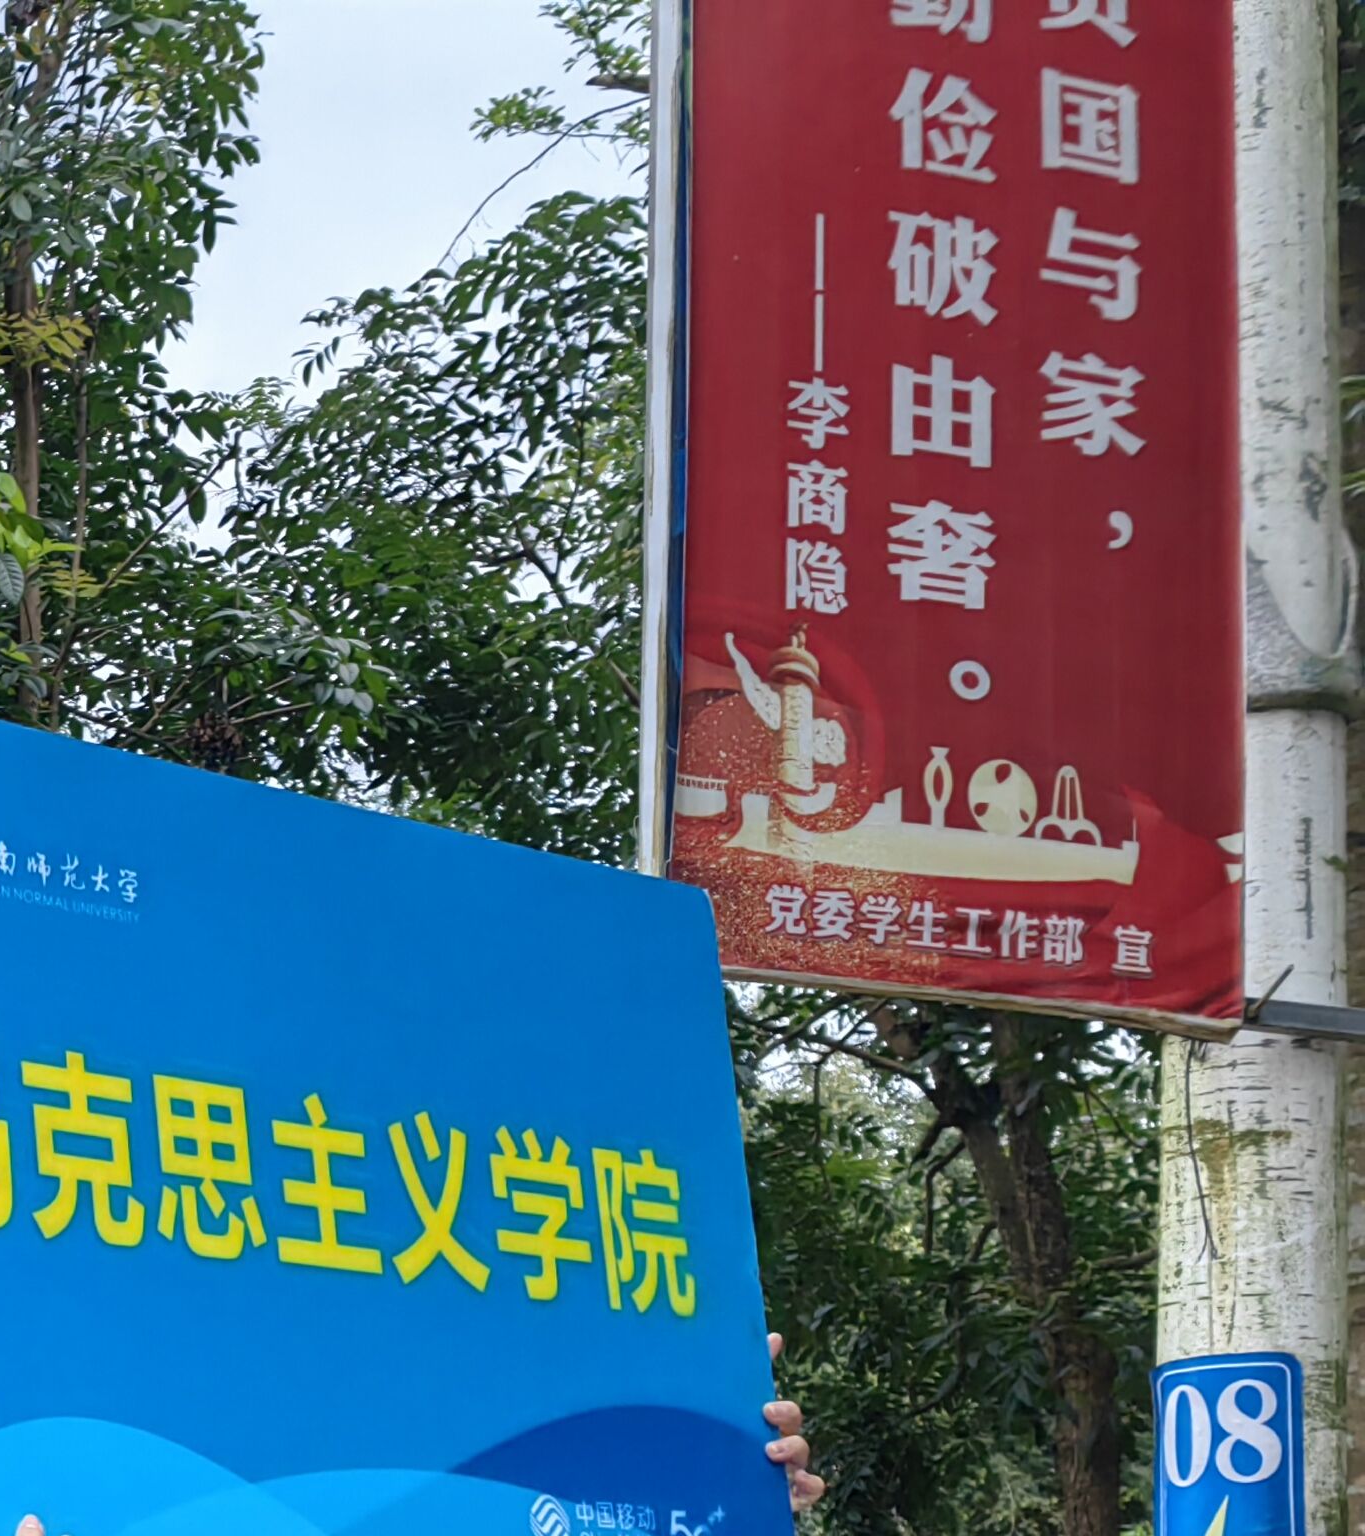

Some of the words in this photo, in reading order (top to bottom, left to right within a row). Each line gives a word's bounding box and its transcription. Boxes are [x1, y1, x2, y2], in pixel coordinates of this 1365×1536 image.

[13, 887, 69, 912] NORMAL
[765, 883, 1085, 966] 党委学生工作部
[1111, 923, 1154, 976] 宣
[1163, 1378, 1283, 1488] 08
[575, 1500, 657, 1531] 中国移动
